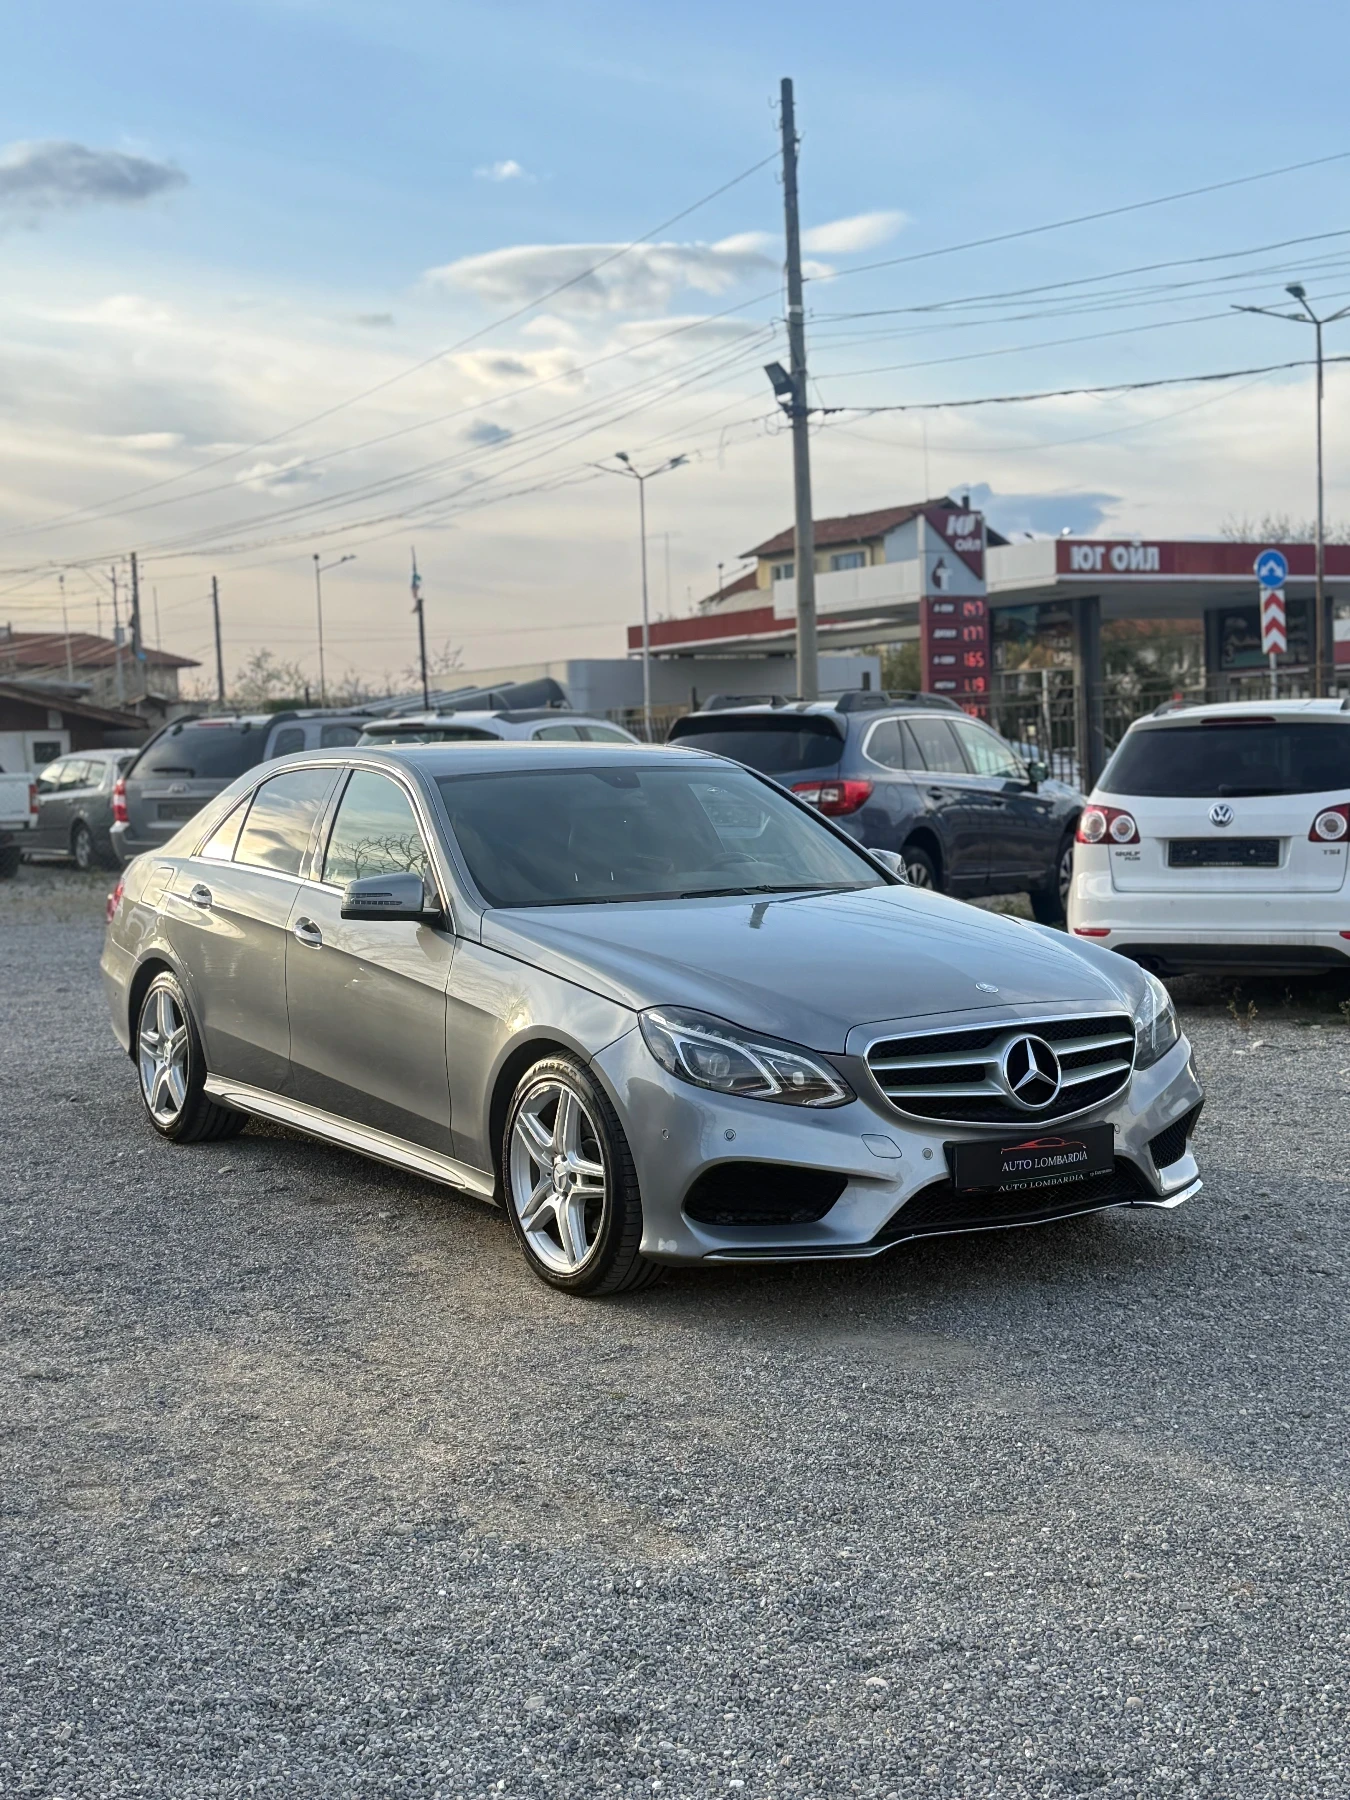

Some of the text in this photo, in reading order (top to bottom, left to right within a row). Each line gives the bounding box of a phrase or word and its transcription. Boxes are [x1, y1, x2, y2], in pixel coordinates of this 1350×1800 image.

[1070, 540, 1160, 571] ЮГ ОЙЛ
[1001, 1150, 1088, 1172] AUTO LOMBARDIA
[998, 1173, 1084, 1192] AUTO LOMBARDIA
